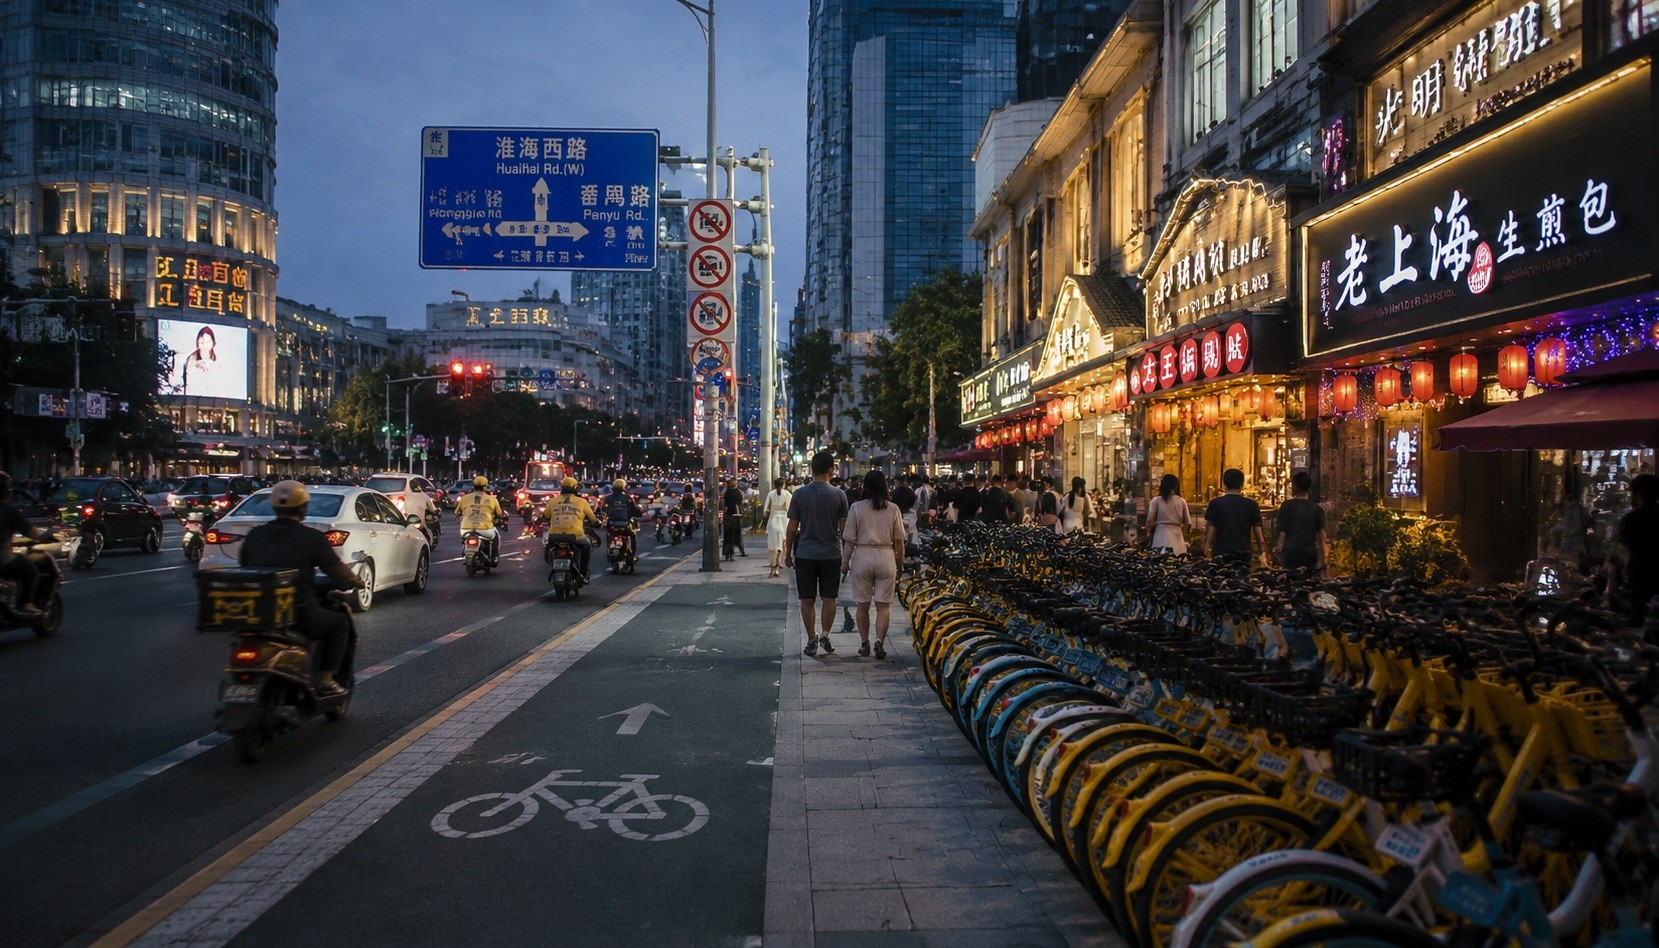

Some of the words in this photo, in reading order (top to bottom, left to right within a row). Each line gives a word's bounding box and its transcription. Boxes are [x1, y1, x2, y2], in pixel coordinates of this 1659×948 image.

[496, 136, 588, 160] 淮海西路
[497, 162, 540, 175] Huaihai
[543, 163, 585, 177] Rd.(W)
[583, 209, 620, 223] Panyu
[1335, 190, 1478, 311] 老上海
[1496, 179, 1617, 264] 生煎包
